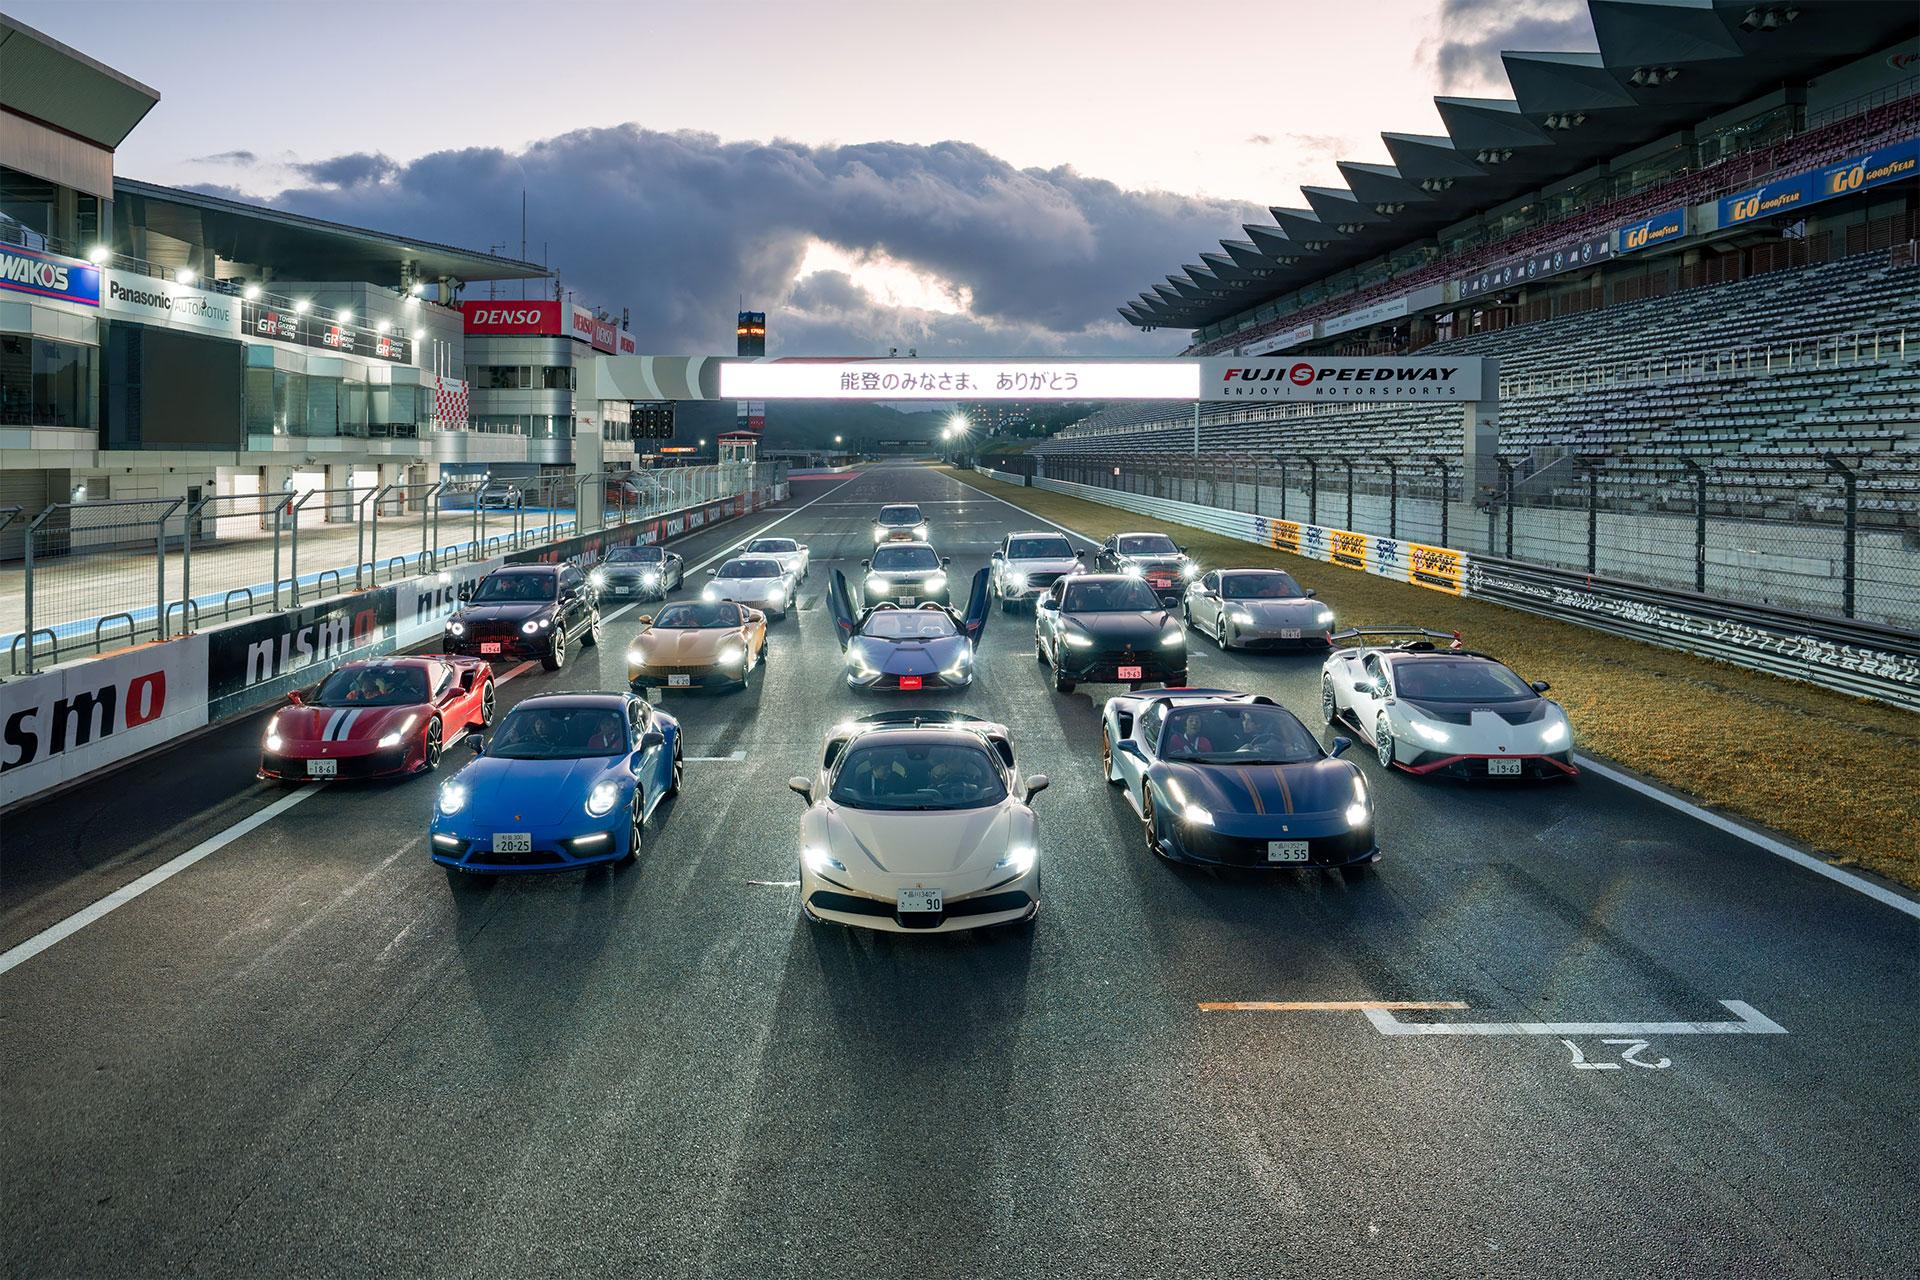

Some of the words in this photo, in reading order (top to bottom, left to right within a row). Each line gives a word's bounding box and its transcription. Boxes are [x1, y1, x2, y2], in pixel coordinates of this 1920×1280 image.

[1833, 166, 1864, 193] GO
[1734, 196, 1759, 220] GO
[1627, 228, 1649, 247] GO
[110, 280, 171, 310] Panasonic
[473, 310, 541, 325] DENSO
[258, 318, 276, 334] GR
[323, 332, 338, 347] GR
[376, 343, 390, 357] GR
[1223, 368, 1287, 381] FUJI
[1289, 362, 1458, 386] SPEEDWAY
[1224, 387, 1291, 396] ENJOY!
[1316, 387, 1456, 396] MOTORSPORTS
[416, 575, 485, 626] nism
[245, 608, 376, 687] nismo
[314, 765, 335, 773] 18-61
[1496, 764, 1520, 773] 19-63
[501, 841, 529, 851] 20-25
